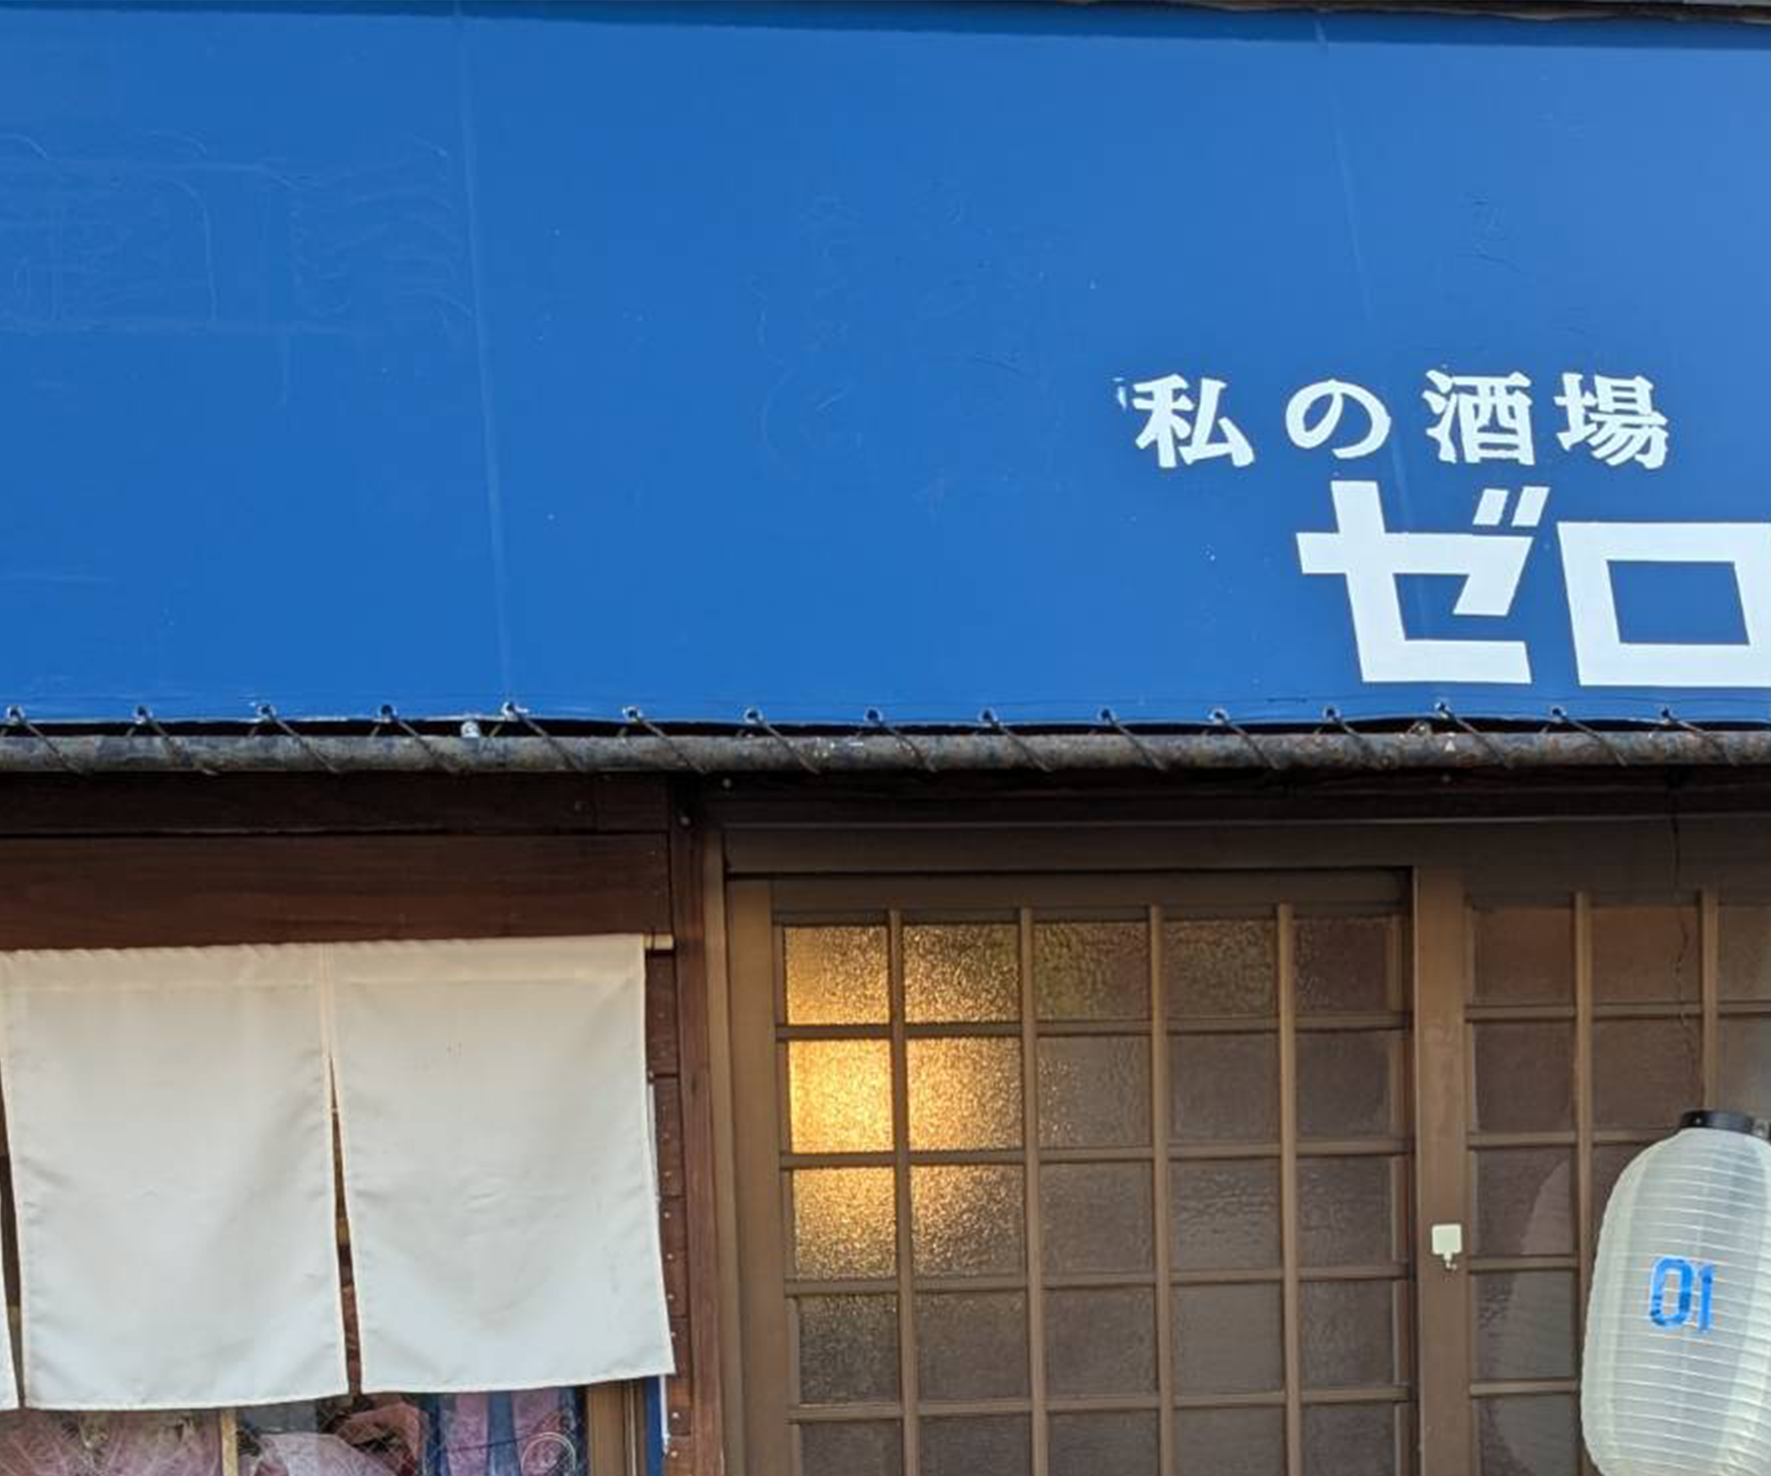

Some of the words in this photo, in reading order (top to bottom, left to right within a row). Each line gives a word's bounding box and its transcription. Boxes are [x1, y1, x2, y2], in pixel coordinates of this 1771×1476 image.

[1132, 370, 1670, 468] 私の酒場
[1649, 1254, 1714, 1334] 01
